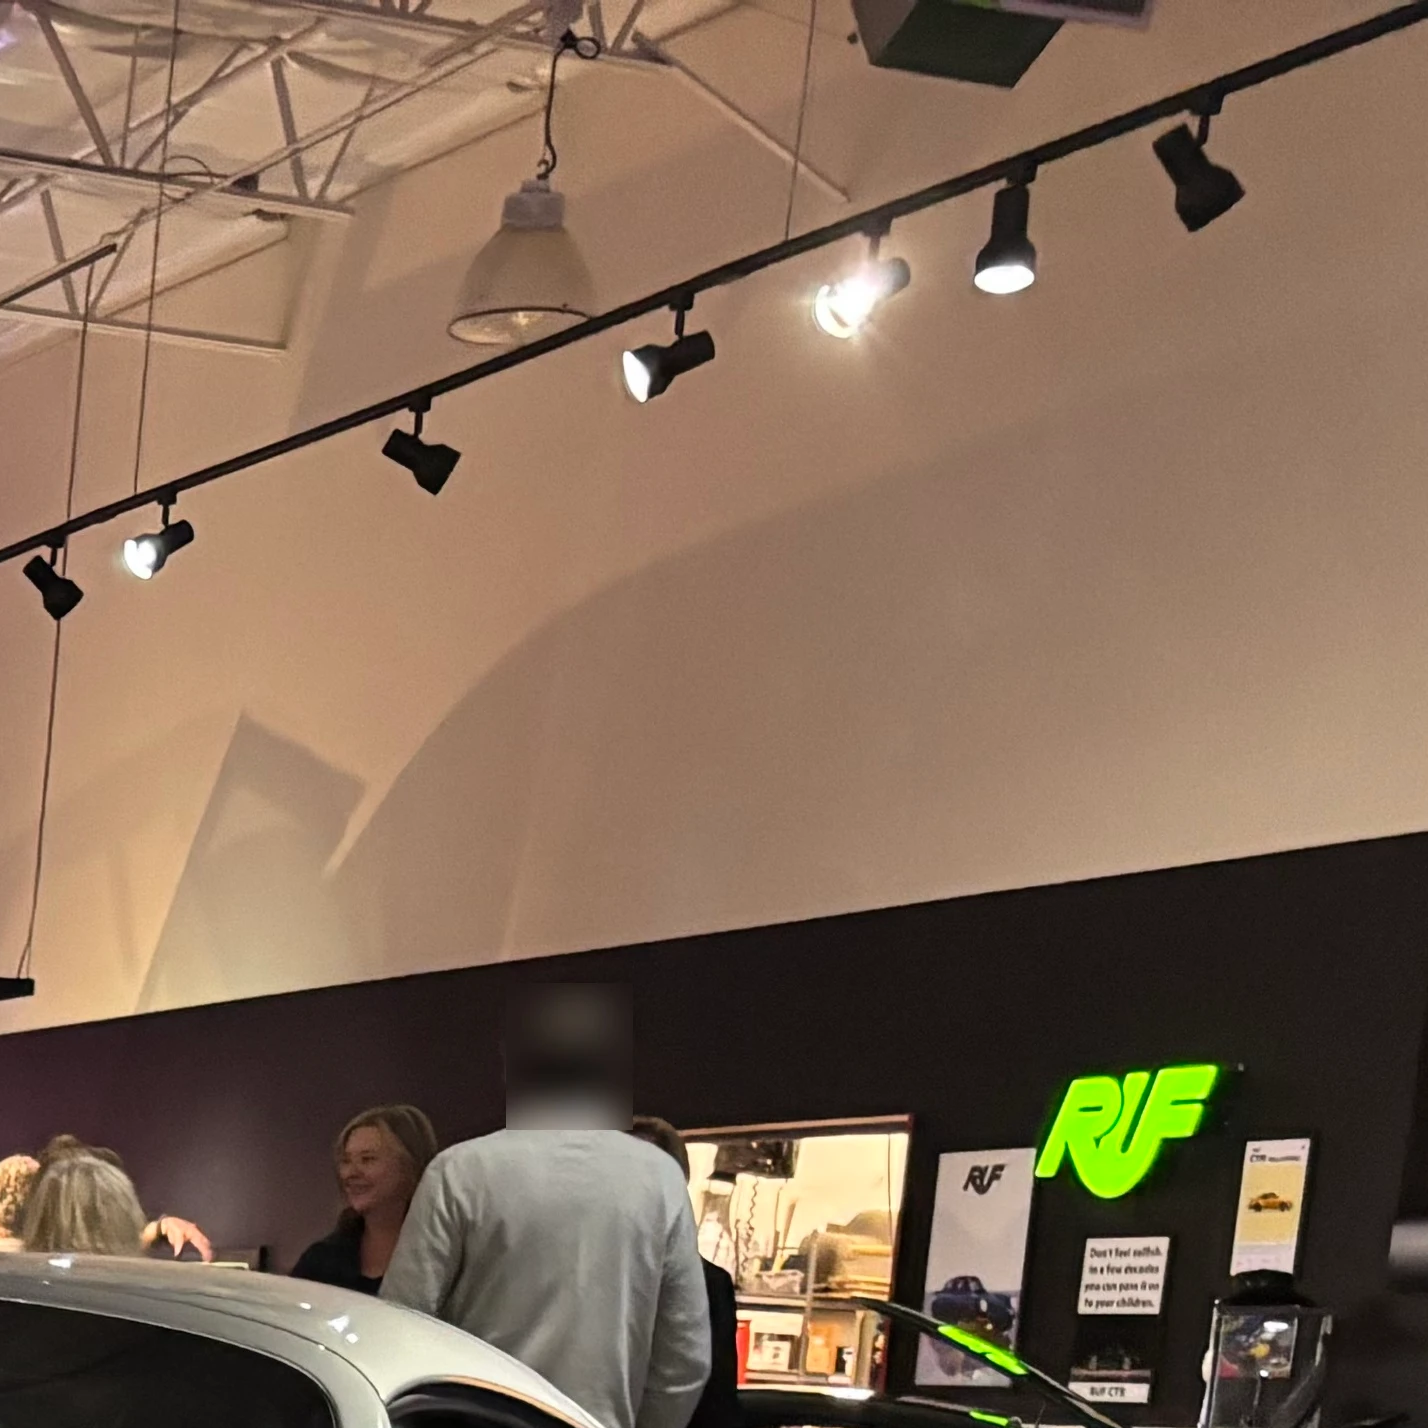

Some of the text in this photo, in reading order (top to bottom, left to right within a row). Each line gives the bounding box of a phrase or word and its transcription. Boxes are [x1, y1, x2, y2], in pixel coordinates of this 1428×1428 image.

[1034, 1064, 1218, 1198] RUF
[962, 1164, 1008, 1195] RUF
[1115, 1247, 1131, 1258] feel
[1106, 1263, 1122, 1275] few
[1124, 1264, 1159, 1274] decades
[1085, 1281, 1159, 1292] you can pass it on
[1084, 1298, 1093, 1308] to
[1095, 1300, 1114, 1309] your
